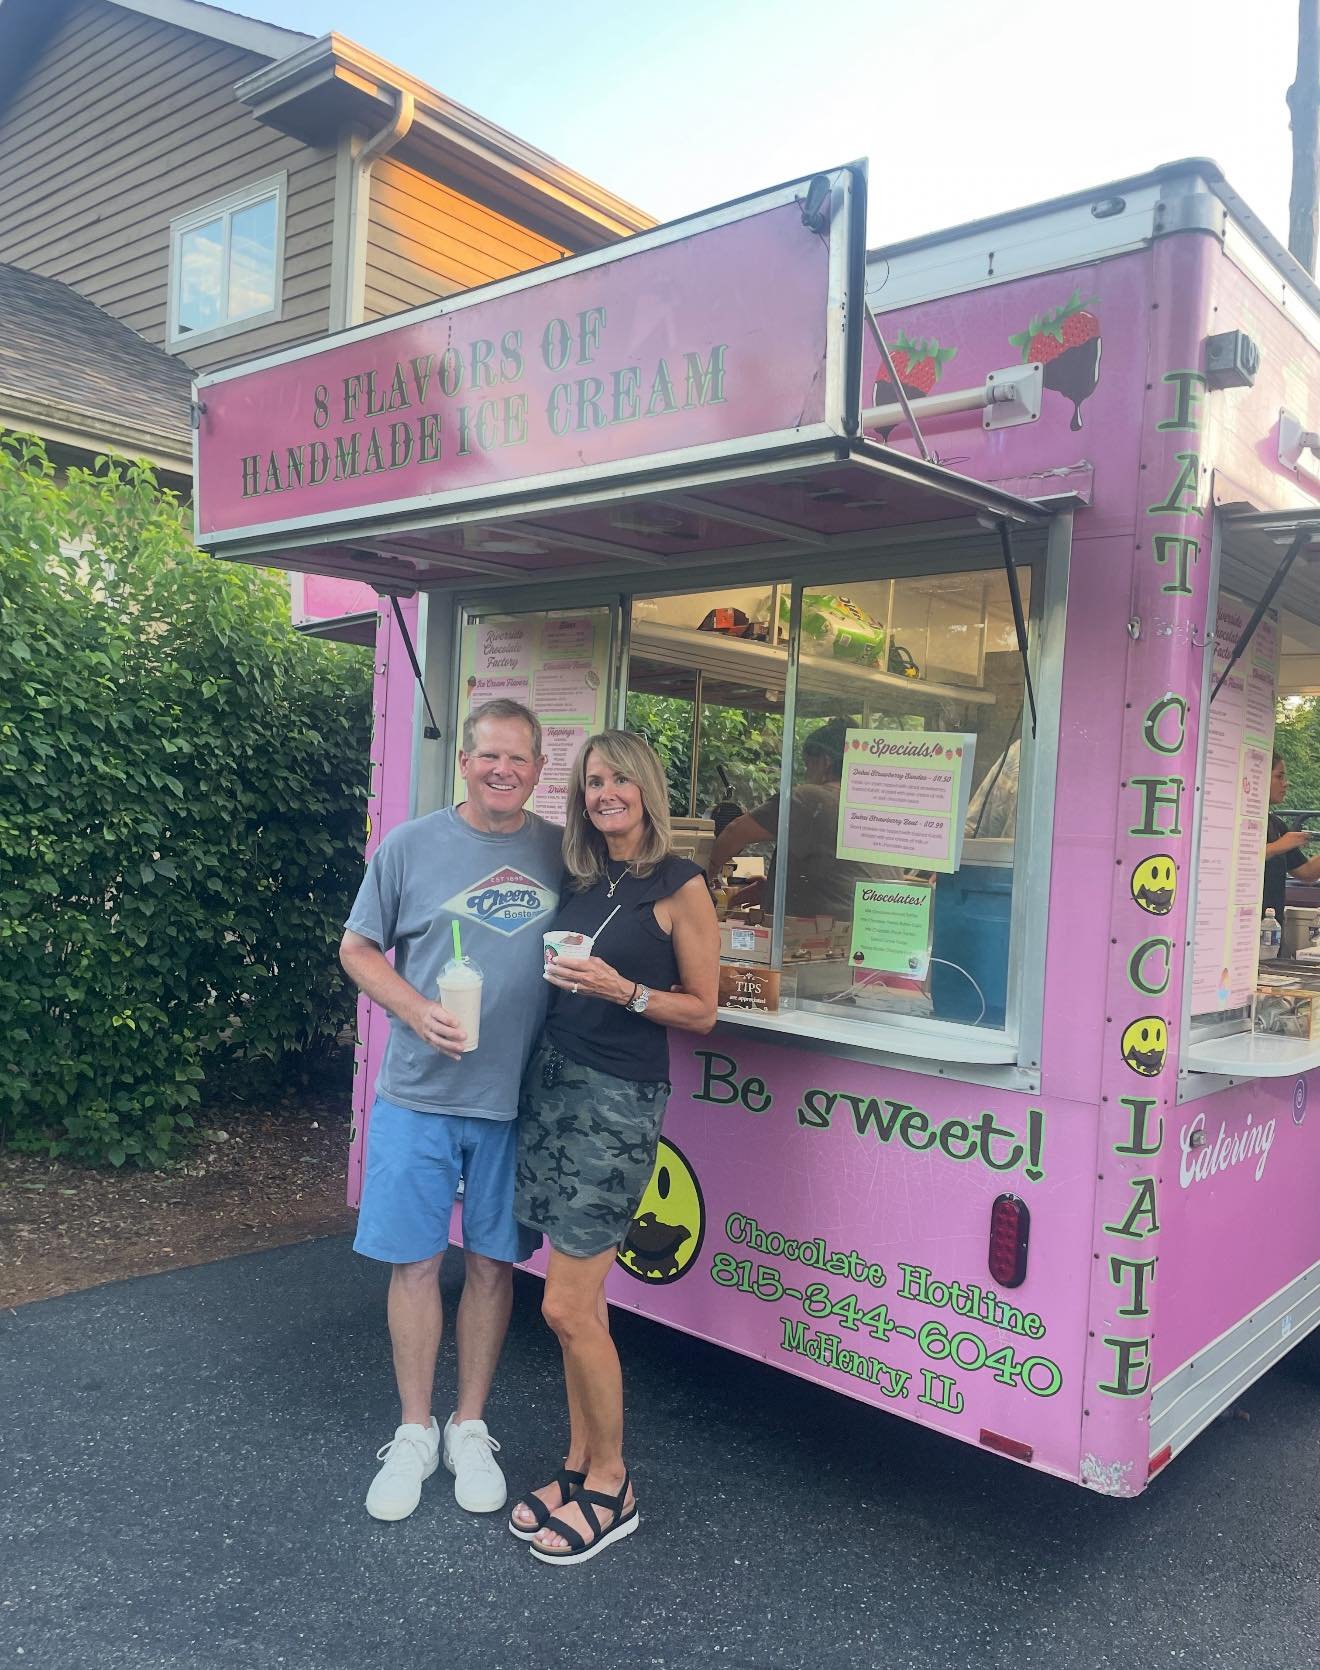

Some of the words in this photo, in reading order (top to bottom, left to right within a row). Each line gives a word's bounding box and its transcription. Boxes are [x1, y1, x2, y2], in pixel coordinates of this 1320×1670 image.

[313, 384, 331, 430] 8
[342, 329, 524, 423] FLAVORS
[541, 306, 607, 371] OF
[241, 412, 442, 498] HANDMADE
[456, 393, 529, 457] ICE
[544, 343, 729, 437] CREAM
[483, 642, 521, 655] Chocolate
[486, 657, 519, 669] Factory
[547, 727, 575, 738] Toppings
[869, 738, 939, 758] Specials!
[466, 888, 541, 917] Cheers
[862, 888, 927, 906] Chocolates!
[735, 981, 762, 994] TIPS
[692, 1049, 772, 1114] Be
[797, 1087, 1047, 1183] sweet!
[1179, 1112, 1276, 1189] Catering
[725, 1212, 887, 1289] Chocolate
[897, 1263, 1046, 1340] Hotline
[710, 1253, 1063, 1397] 815-344-6040
[779, 1317, 910, 1399] McHenry,
[919, 1370, 964, 1415] IL
